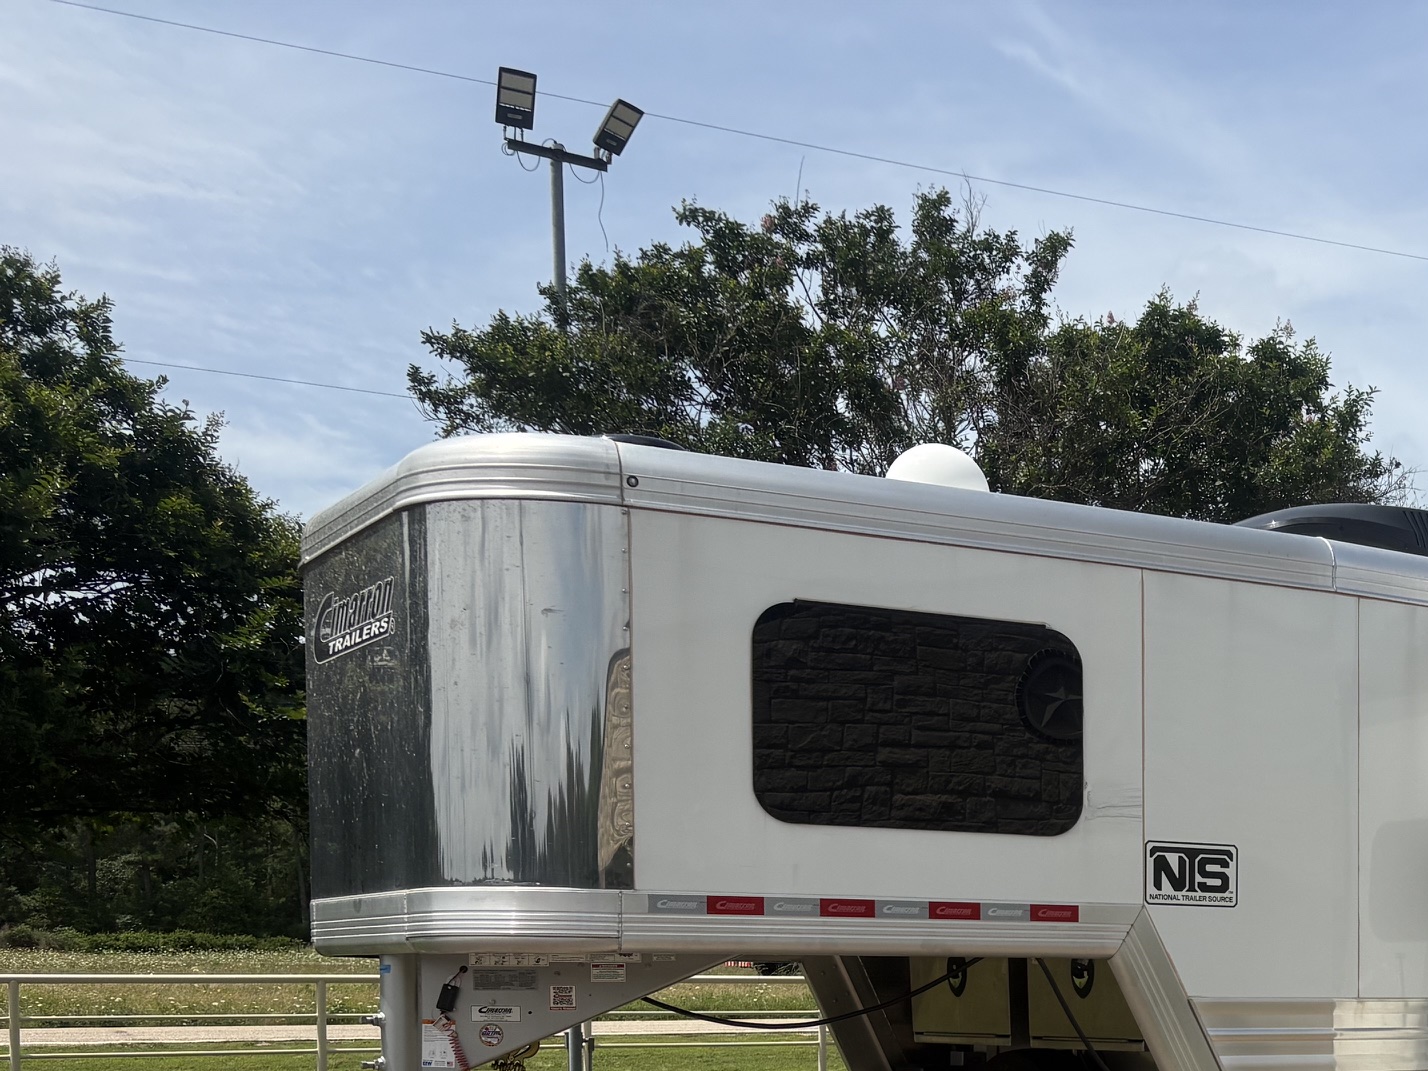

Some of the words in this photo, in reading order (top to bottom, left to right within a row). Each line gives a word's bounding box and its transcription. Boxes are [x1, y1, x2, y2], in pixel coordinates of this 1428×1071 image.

[328, 617, 389, 655] TRAILERS
[1149, 846, 1233, 893] NTS
[1149, 893, 1180, 901] NATIONAL
[1181, 894, 1207, 902] TRAILER
